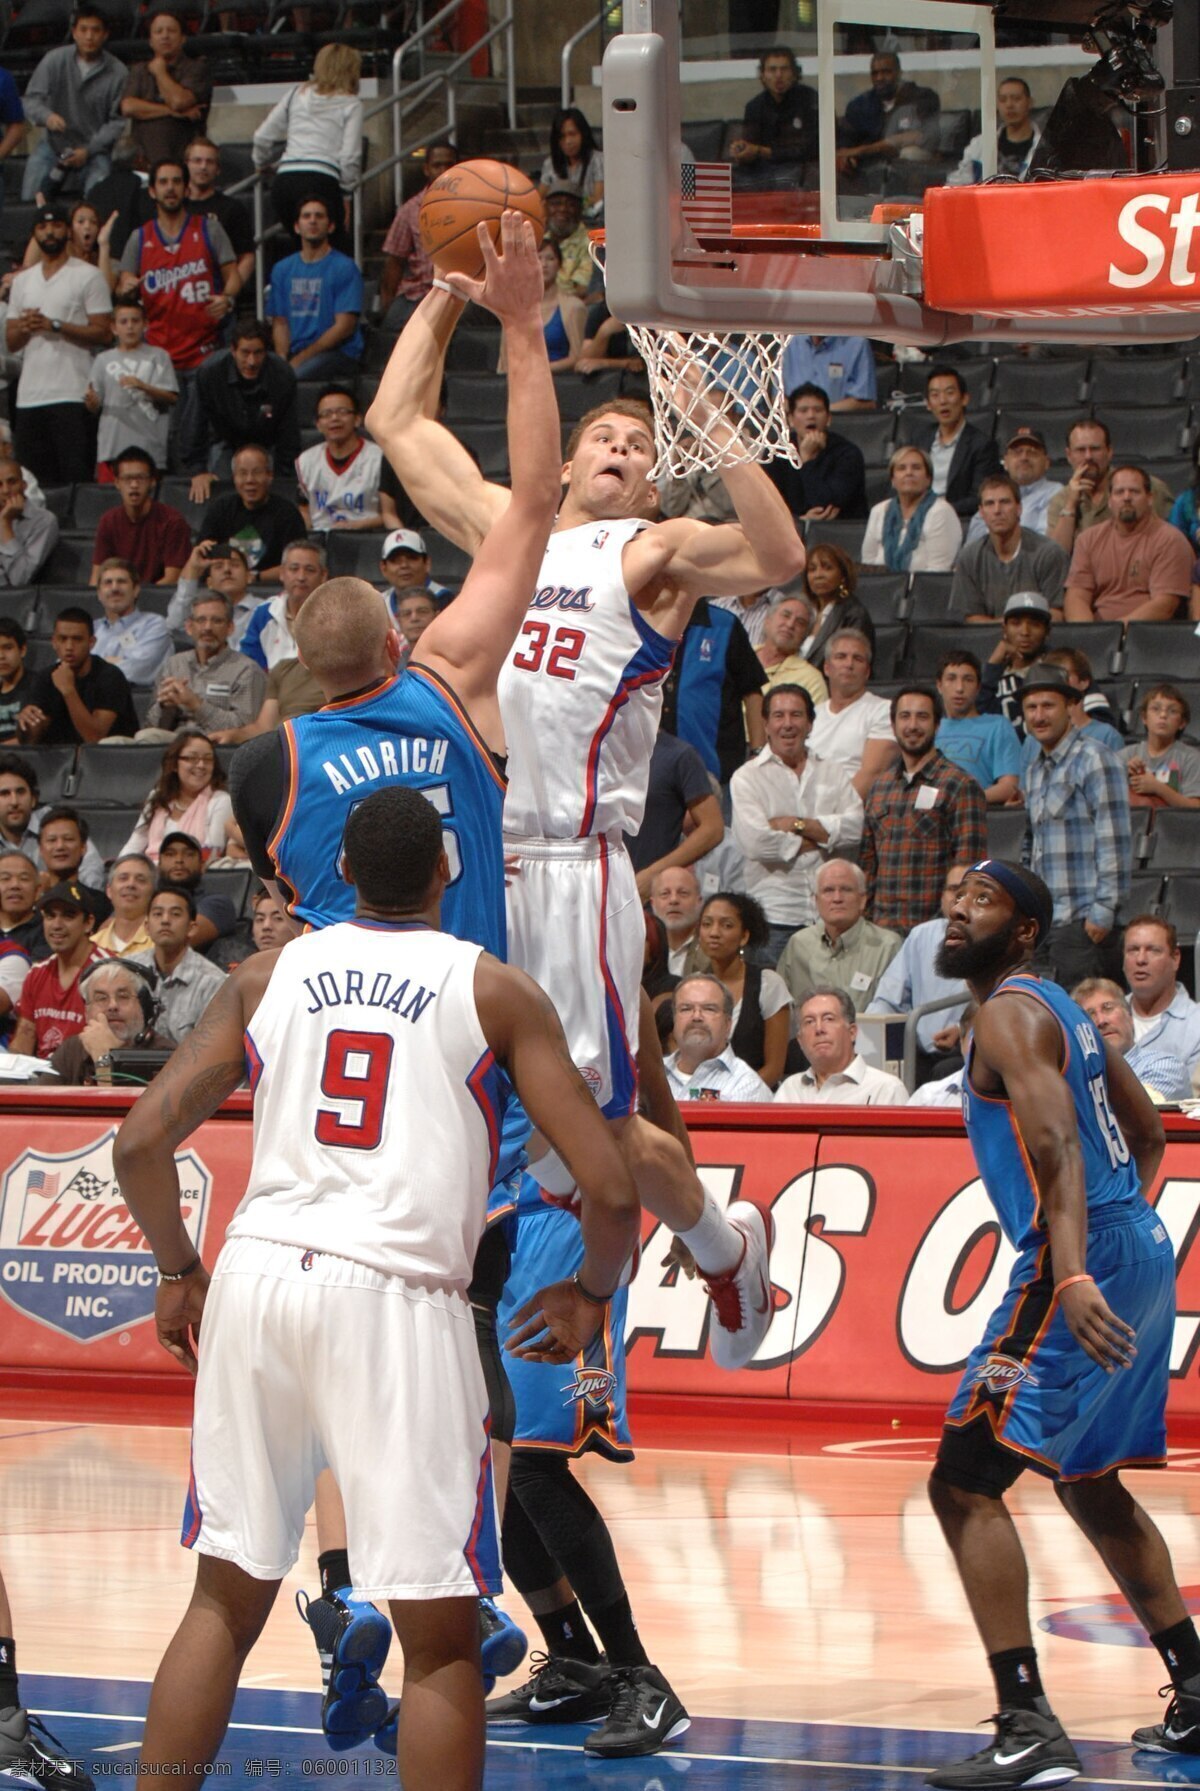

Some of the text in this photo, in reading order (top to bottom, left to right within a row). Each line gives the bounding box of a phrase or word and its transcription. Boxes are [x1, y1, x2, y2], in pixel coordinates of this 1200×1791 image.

[144, 259, 208, 294] Clippers
[180, 281, 211, 304] 42
[528, 585, 595, 612] ers
[513, 620, 586, 681] 32
[322, 737, 449, 796] ALDRICH
[302, 969, 436, 1024] JORDAN
[314, 1028, 395, 1151] 9
[18, 1202, 192, 1250] LUCA
[3, 1260, 161, 1287] OIL PRODUCT
[65, 1296, 113, 1317] INC.
